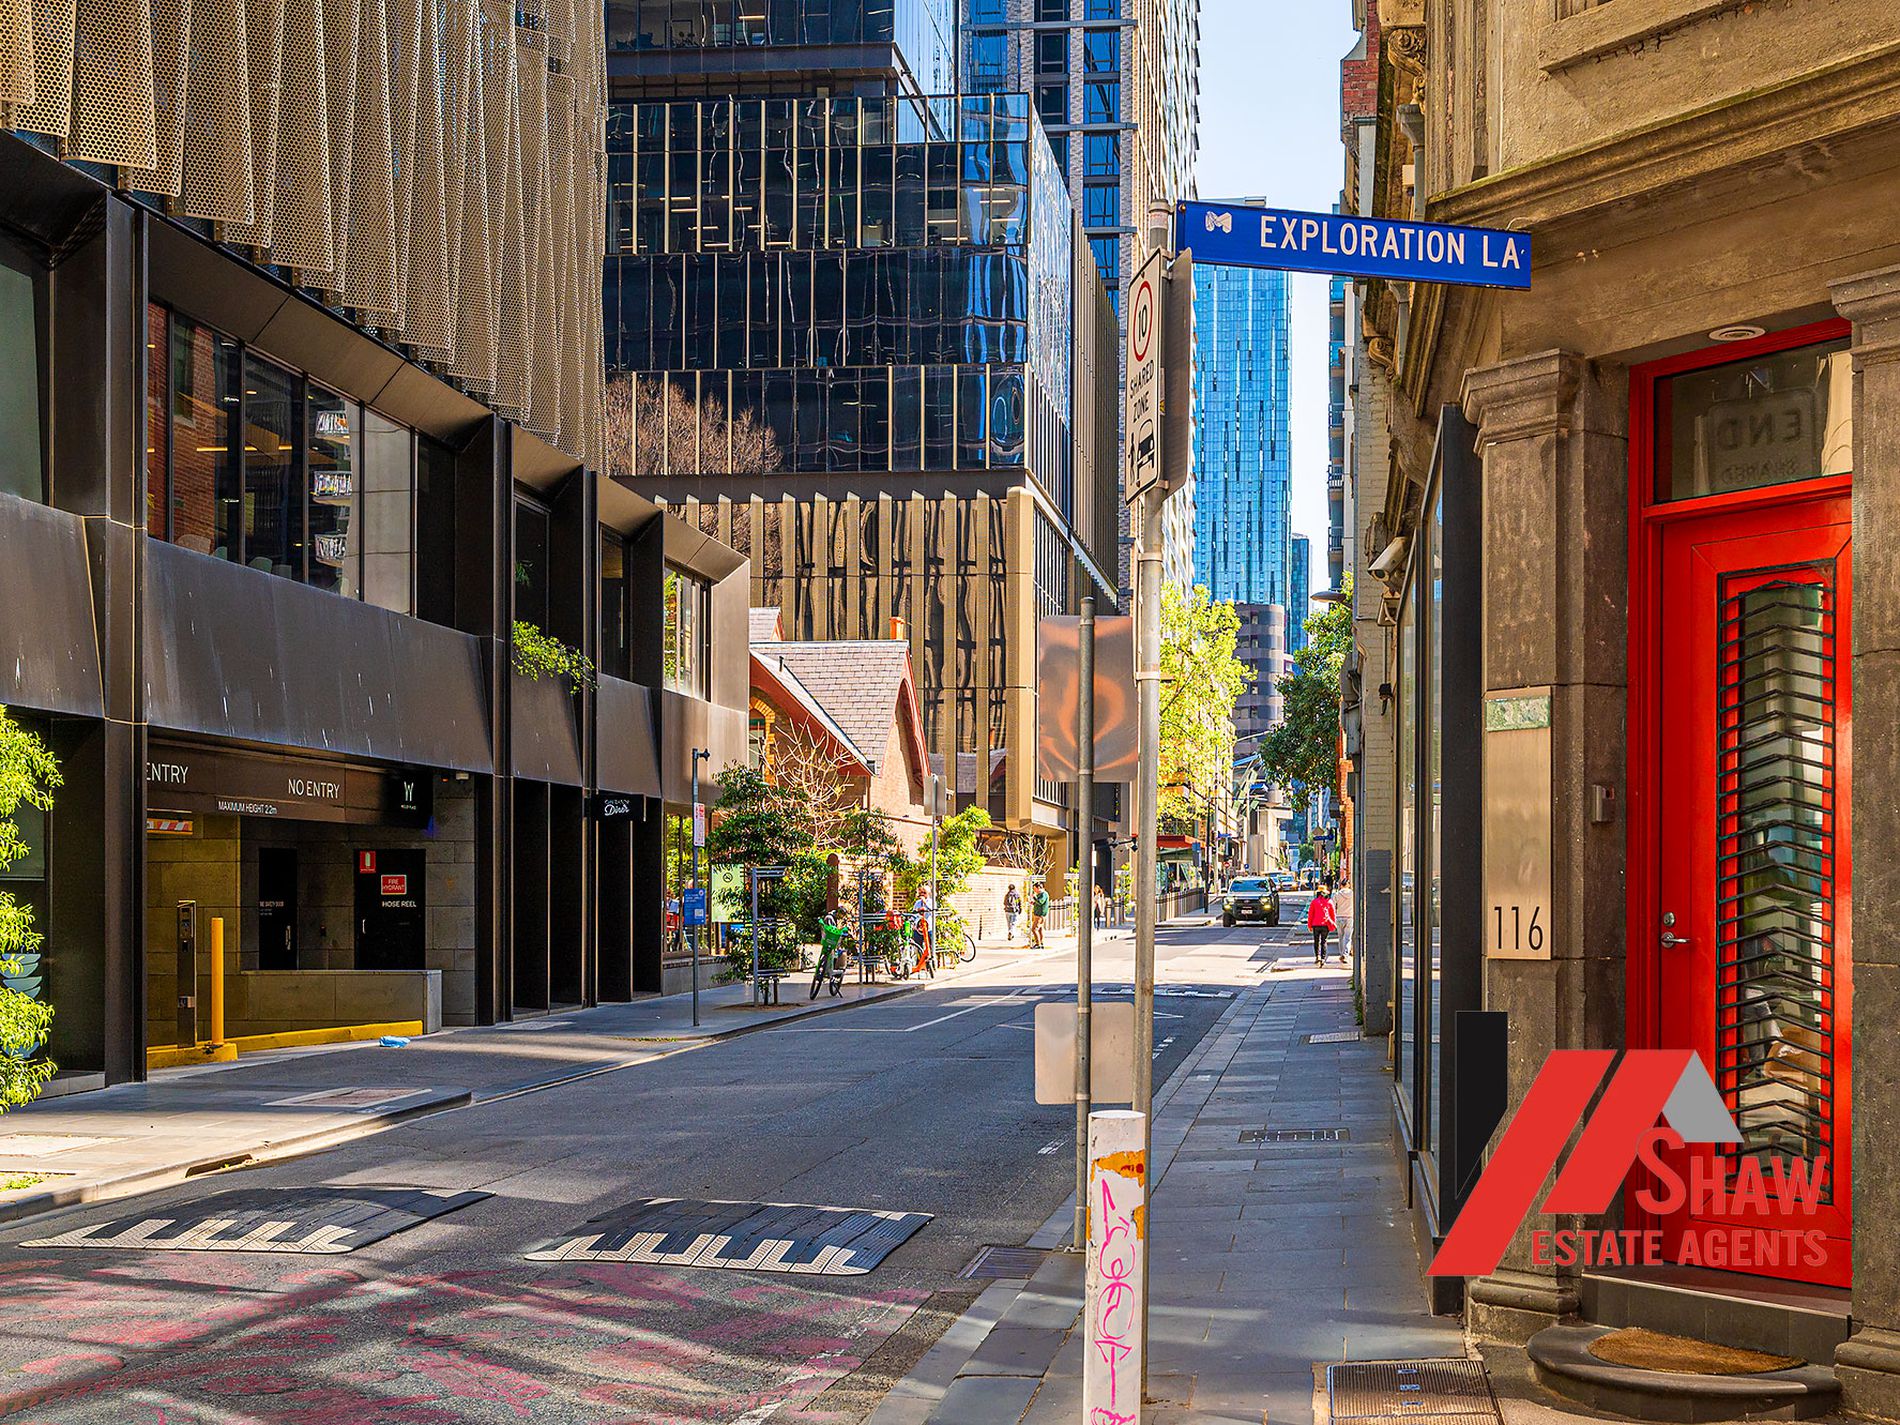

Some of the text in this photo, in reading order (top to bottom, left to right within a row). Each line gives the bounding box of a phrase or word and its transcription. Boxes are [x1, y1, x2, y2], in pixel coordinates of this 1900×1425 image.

[1260, 215, 1520, 269] EXPLORATION LA
[1137, 304, 1148, 342] 10
[1129, 359, 1155, 399] SHARED
[1132, 390, 1150, 423] ZONE
[288, 779, 340, 799] NO ENTRY
[218, 801, 245, 812] MAXIMUM
[245, 803, 264, 814] HEIGHT
[382, 900, 417, 908] HOSE REEL
[1493, 905, 1544, 951] 116
